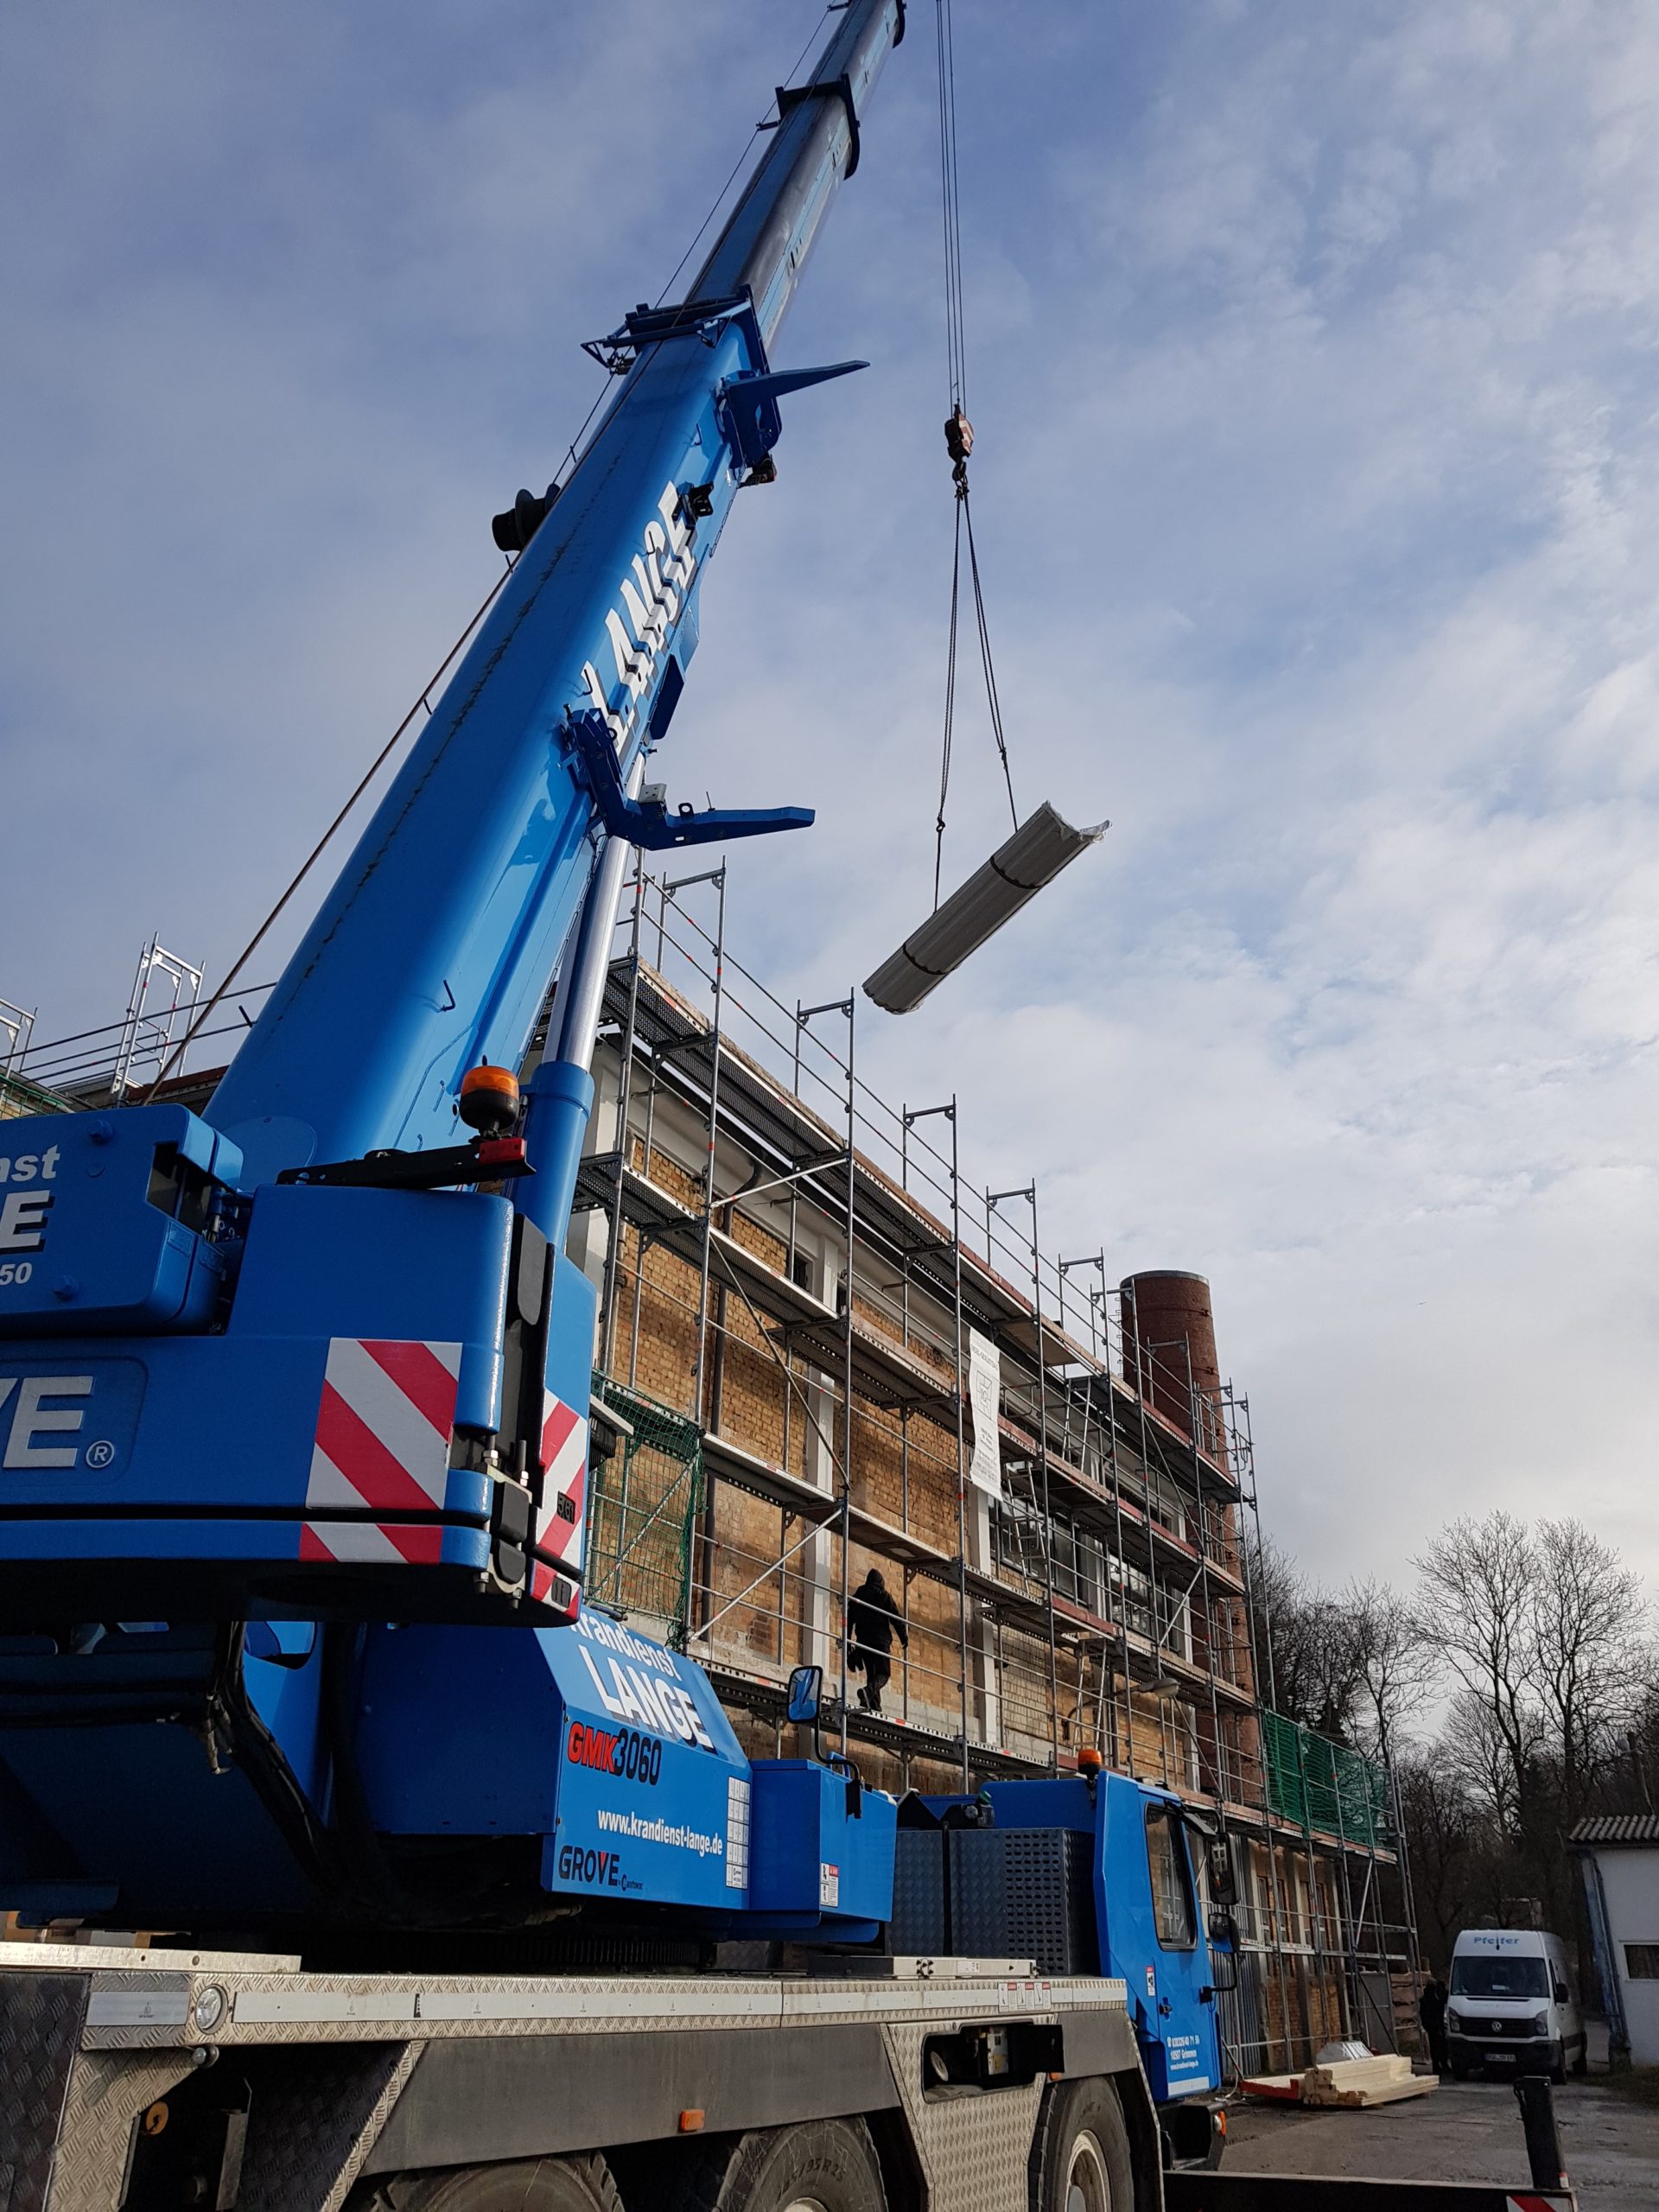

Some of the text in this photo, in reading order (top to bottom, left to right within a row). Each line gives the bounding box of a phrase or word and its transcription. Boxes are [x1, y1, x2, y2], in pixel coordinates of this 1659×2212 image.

[578, 1644, 716, 1751] LANGE
[598, 1809, 722, 1857] www.krandienst-lange.de
[558, 1845, 620, 1886] GROVE
